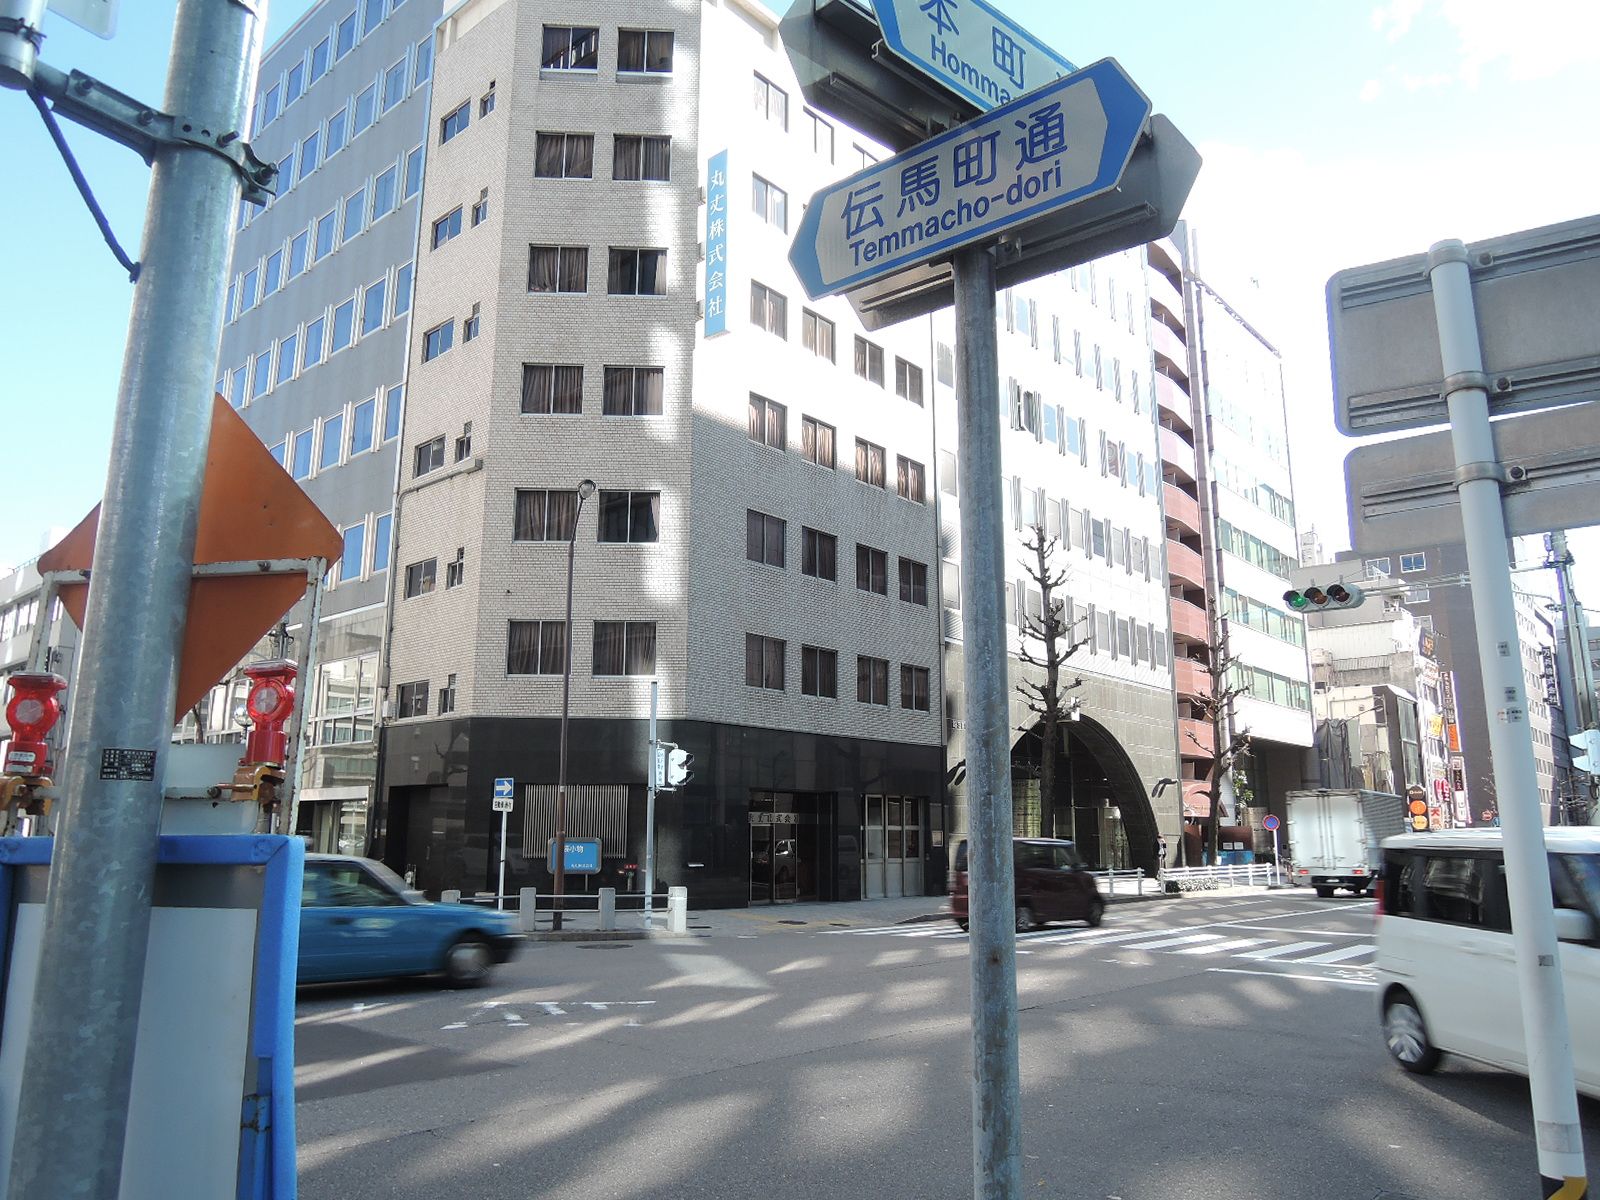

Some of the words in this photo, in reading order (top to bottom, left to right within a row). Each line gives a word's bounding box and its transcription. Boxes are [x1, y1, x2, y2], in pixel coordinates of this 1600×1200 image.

[920, 0, 1061, 90] 本町
[841, 101, 1068, 241] 伝馬町通
[849, 159, 1063, 267] Temmacho-dori
